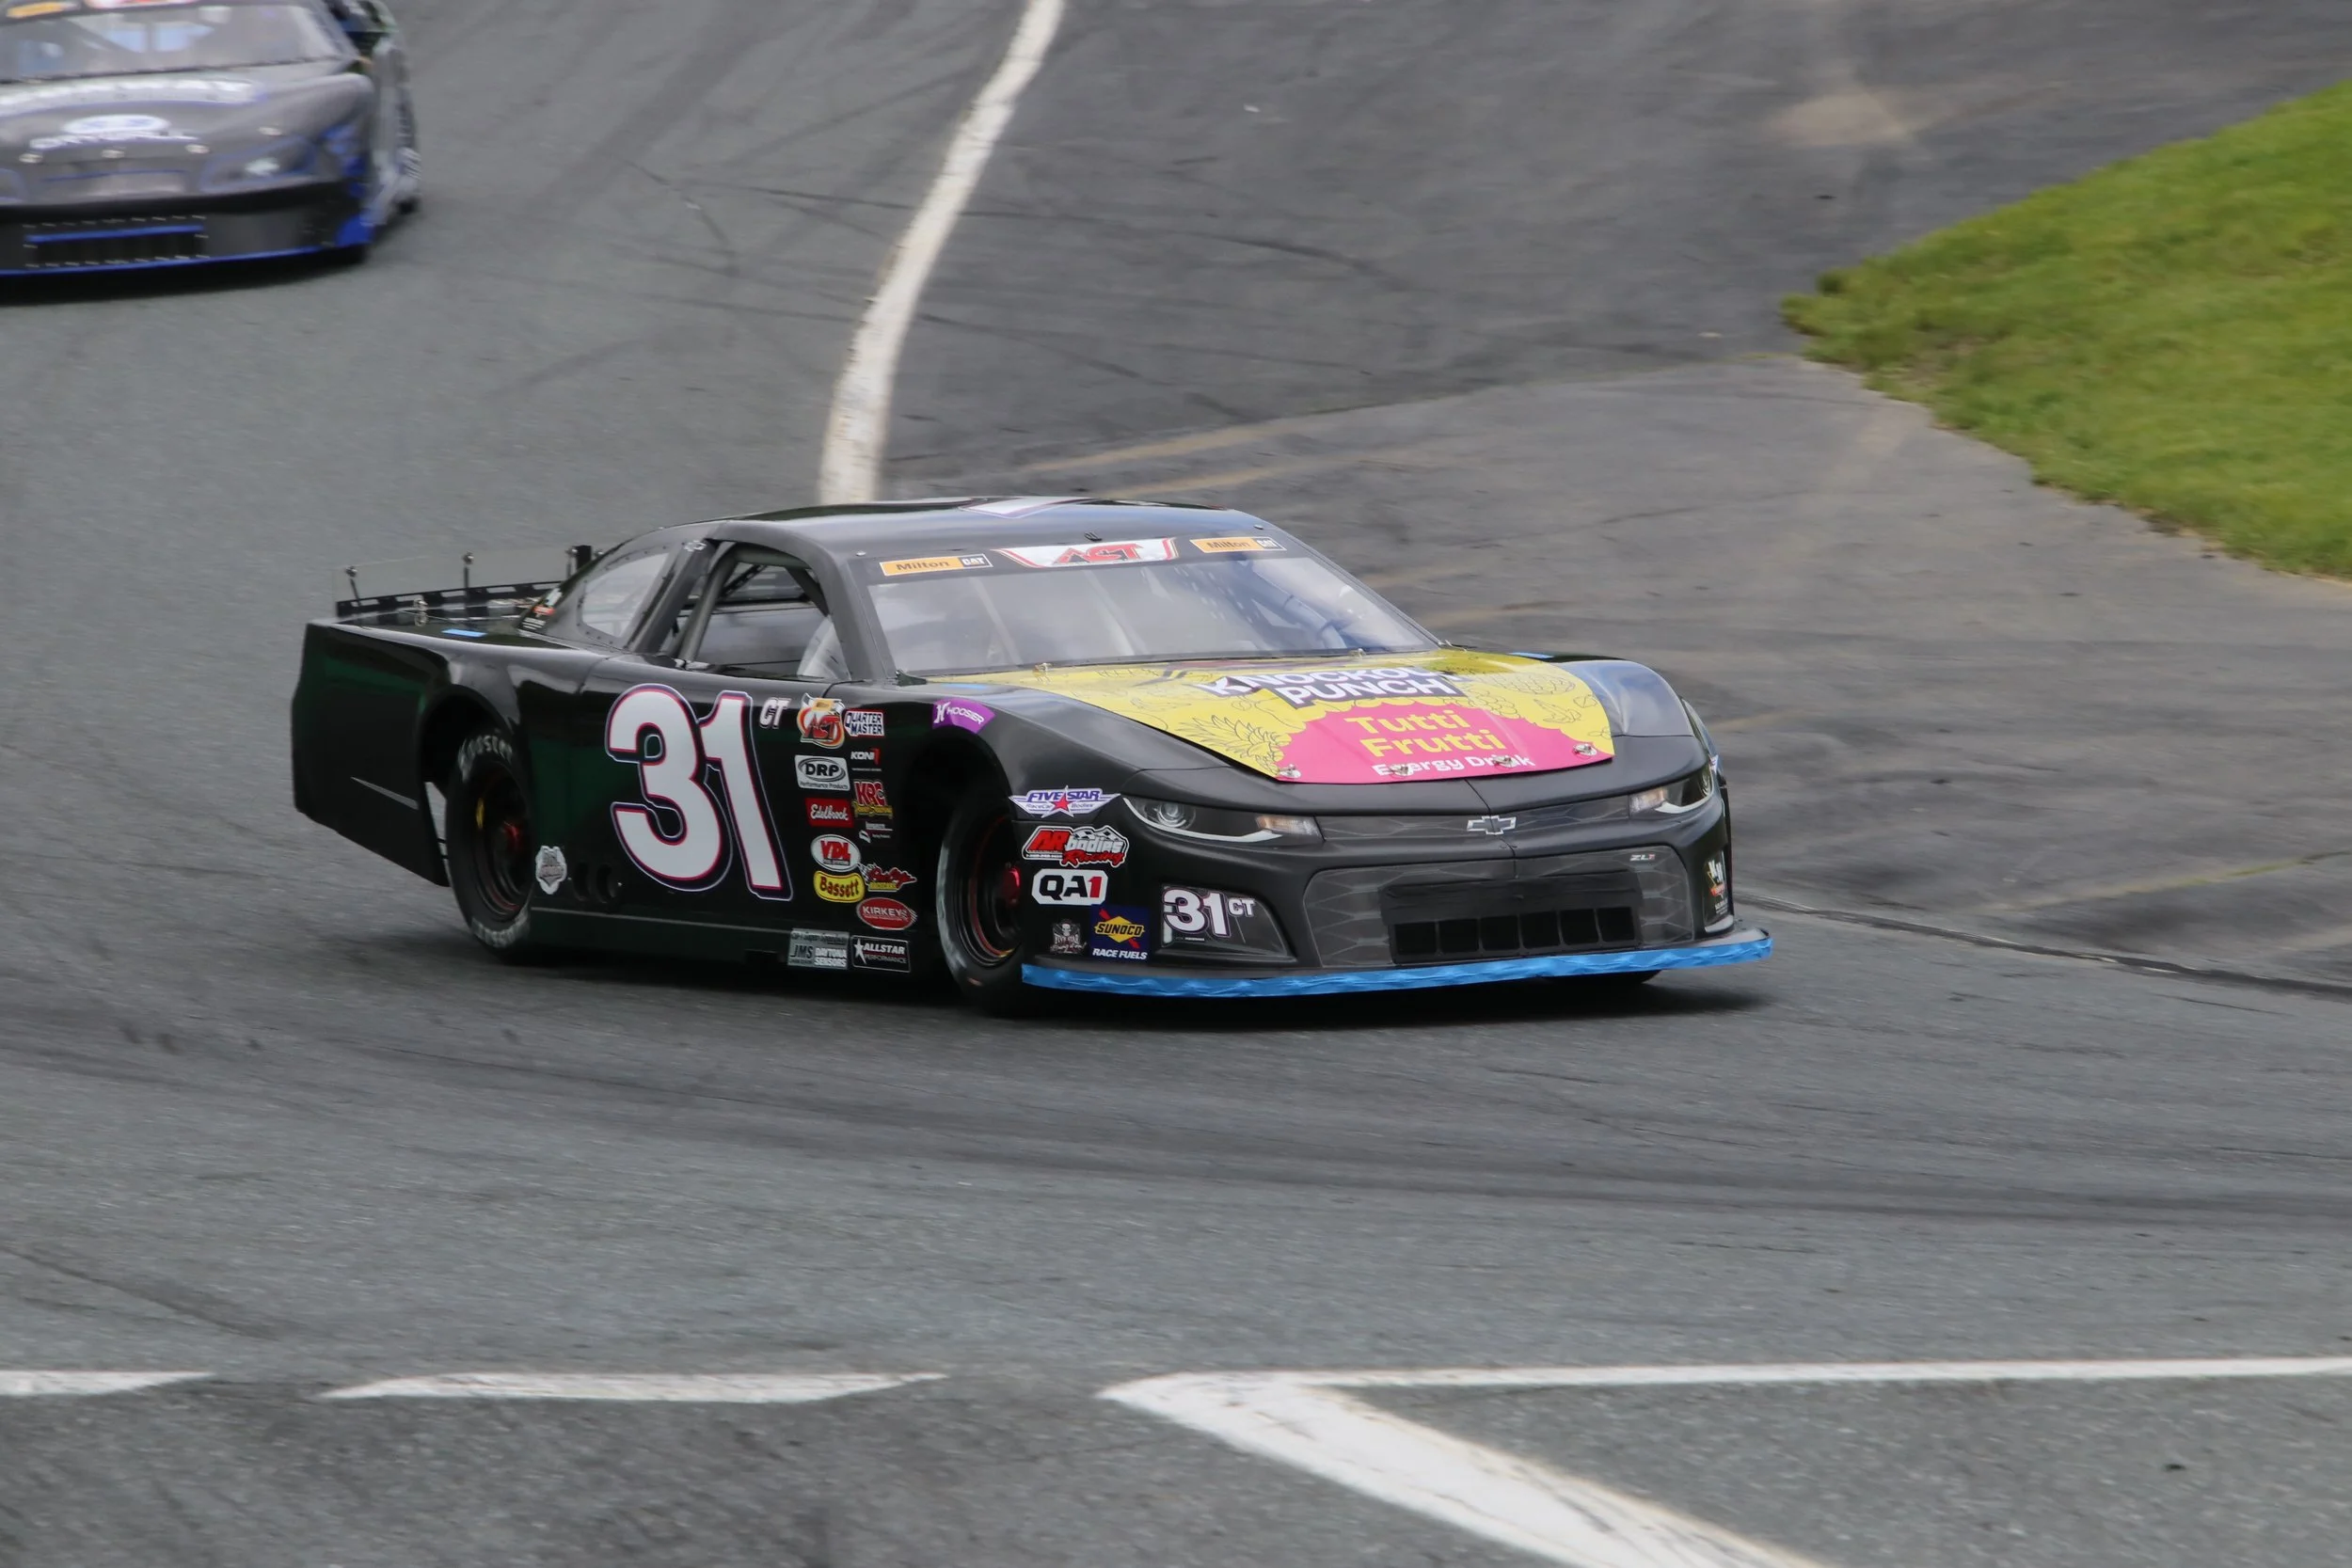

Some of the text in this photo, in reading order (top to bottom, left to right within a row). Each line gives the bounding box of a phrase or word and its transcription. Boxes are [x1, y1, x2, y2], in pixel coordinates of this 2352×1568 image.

[1206, 541, 1250, 549] Milton
[1052, 543, 1144, 565] ACT
[896, 557, 985, 571] Milton CAT
[1276, 678, 1457, 705] PUNCH
[846, 712, 882, 726] QUARTER
[1344, 709, 1470, 734] Tutti
[850, 723, 882, 734] MASTER
[1359, 729, 1507, 757] Frutti
[850, 751, 875, 760] KONI
[805, 763, 840, 777] DRP
[1372, 757, 1465, 777] Eergy
[606, 684, 792, 900] 31 CT
[1027, 790, 1100, 802] FIVE STAR
[811, 803, 849, 820] Edelbrock
[1027, 830, 1124, 853] AR bodies
[820, 840, 850, 862] VDL
[1061, 848, 1125, 866] Racing
[819, 876, 859, 897] Bassett
[1039, 875, 1102, 900] QA1
[862, 906, 902, 917] KIRKEY
[1163, 888, 1256, 937] 31 CT
[1096, 923, 1143, 936] SUNOCO
[790, 944, 814, 959] JMS
[863, 942, 905, 955] ALLSTAR
[1092, 947, 1119, 958] RACE
[1119, 950, 1148, 960] FUELS
